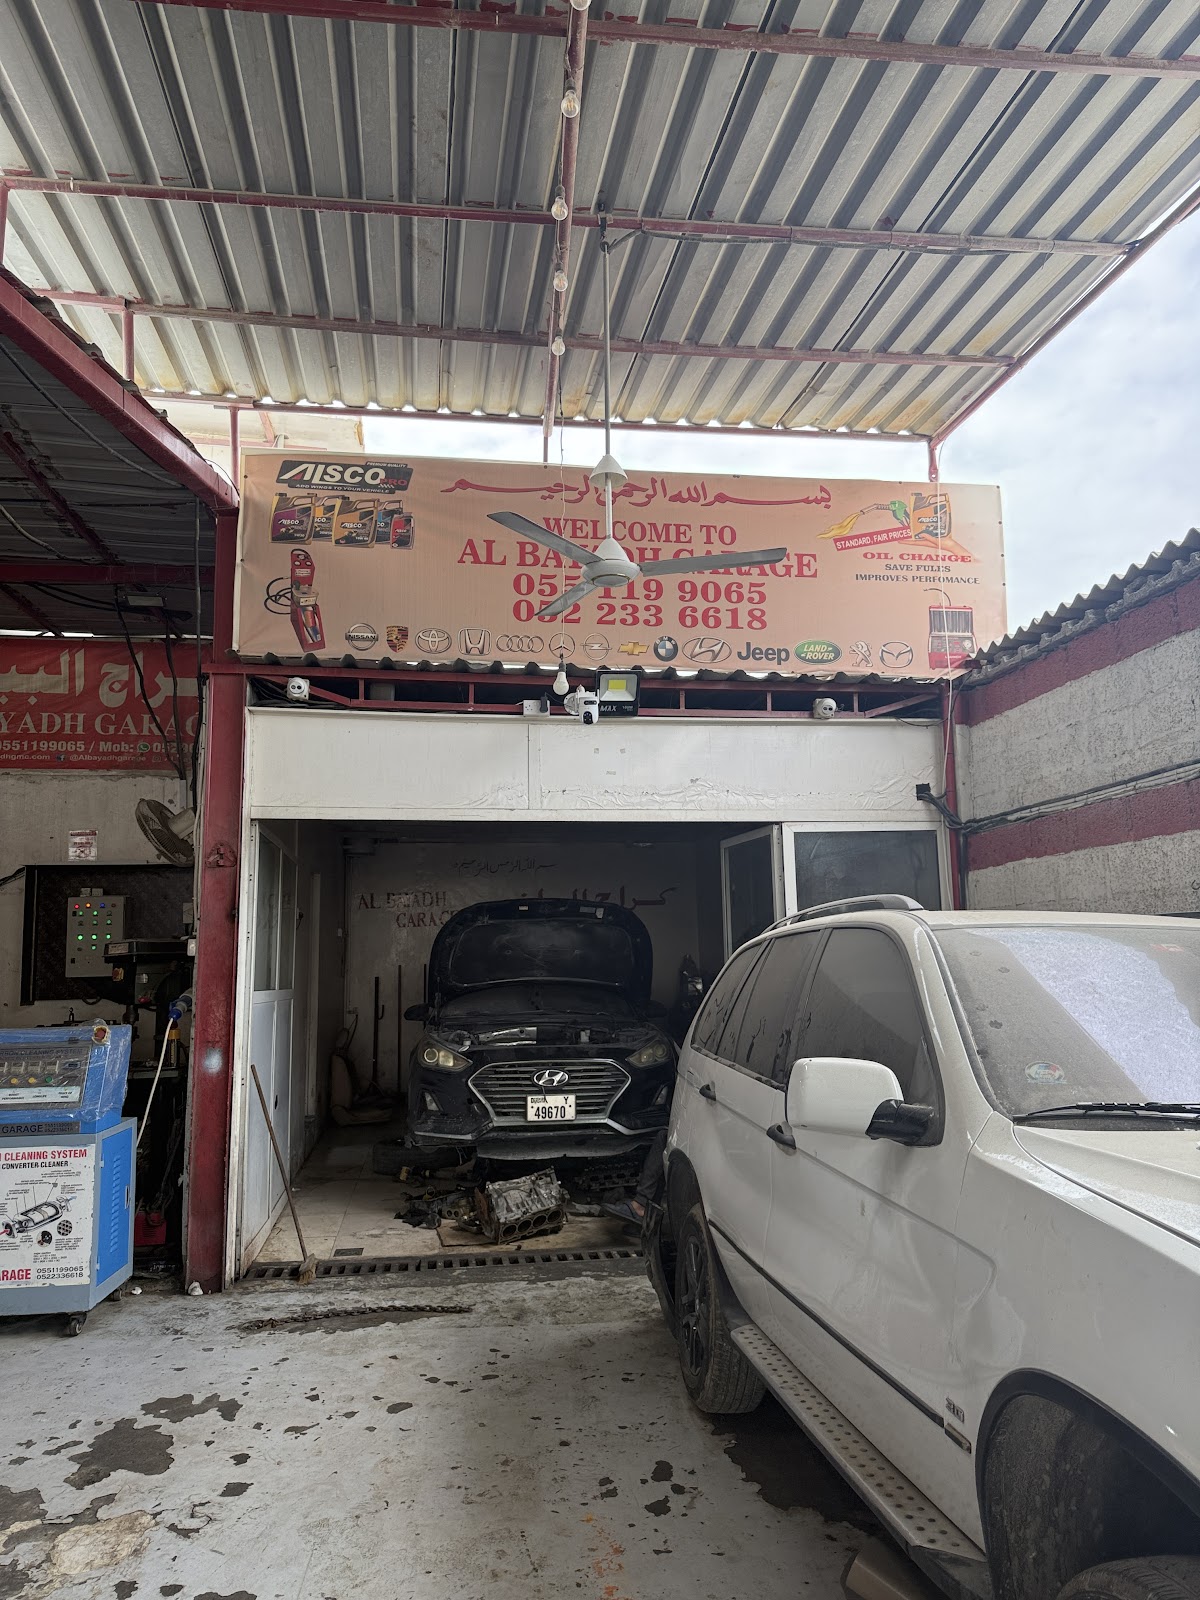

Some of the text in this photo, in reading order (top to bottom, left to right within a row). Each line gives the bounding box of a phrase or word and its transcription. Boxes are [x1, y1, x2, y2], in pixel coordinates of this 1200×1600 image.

[542, 516, 737, 546] WELCOME TO
[874, 533, 888, 544] FAIR
[888, 528, 912, 542] PRICES
[457, 538, 507, 566] AL
[862, 552, 972, 563] OIL CHANGE
[885, 563, 913, 572] SAVE
[855, 573, 980, 585] IMPROVES PERFOMANCE
[677, 579, 767, 605] 9065
[596, 602, 664, 628] 233
[678, 605, 768, 631] 6618
[348, 633, 377, 641] NISSAN
[737, 641, 790, 665] Jeep
[803, 644, 828, 653] LAND
[805, 652, 835, 661] ROVER
[0, 740, 85, 752] 551199065
[100, 741, 134, 754] Mob:
[563, 1096, 570, 1105] Y
[534, 1105, 566, 1120] 49670
[1, 1124, 43, 1134] GARAGE
[4, 1148, 87, 1161] CLEANING SYSTEM
[1, 1160, 69, 1170] CONVERTER CLEANER
[0, 1265, 84, 1281] RAGE 0551199065
[36, 1272, 84, 1280] 0522336618
